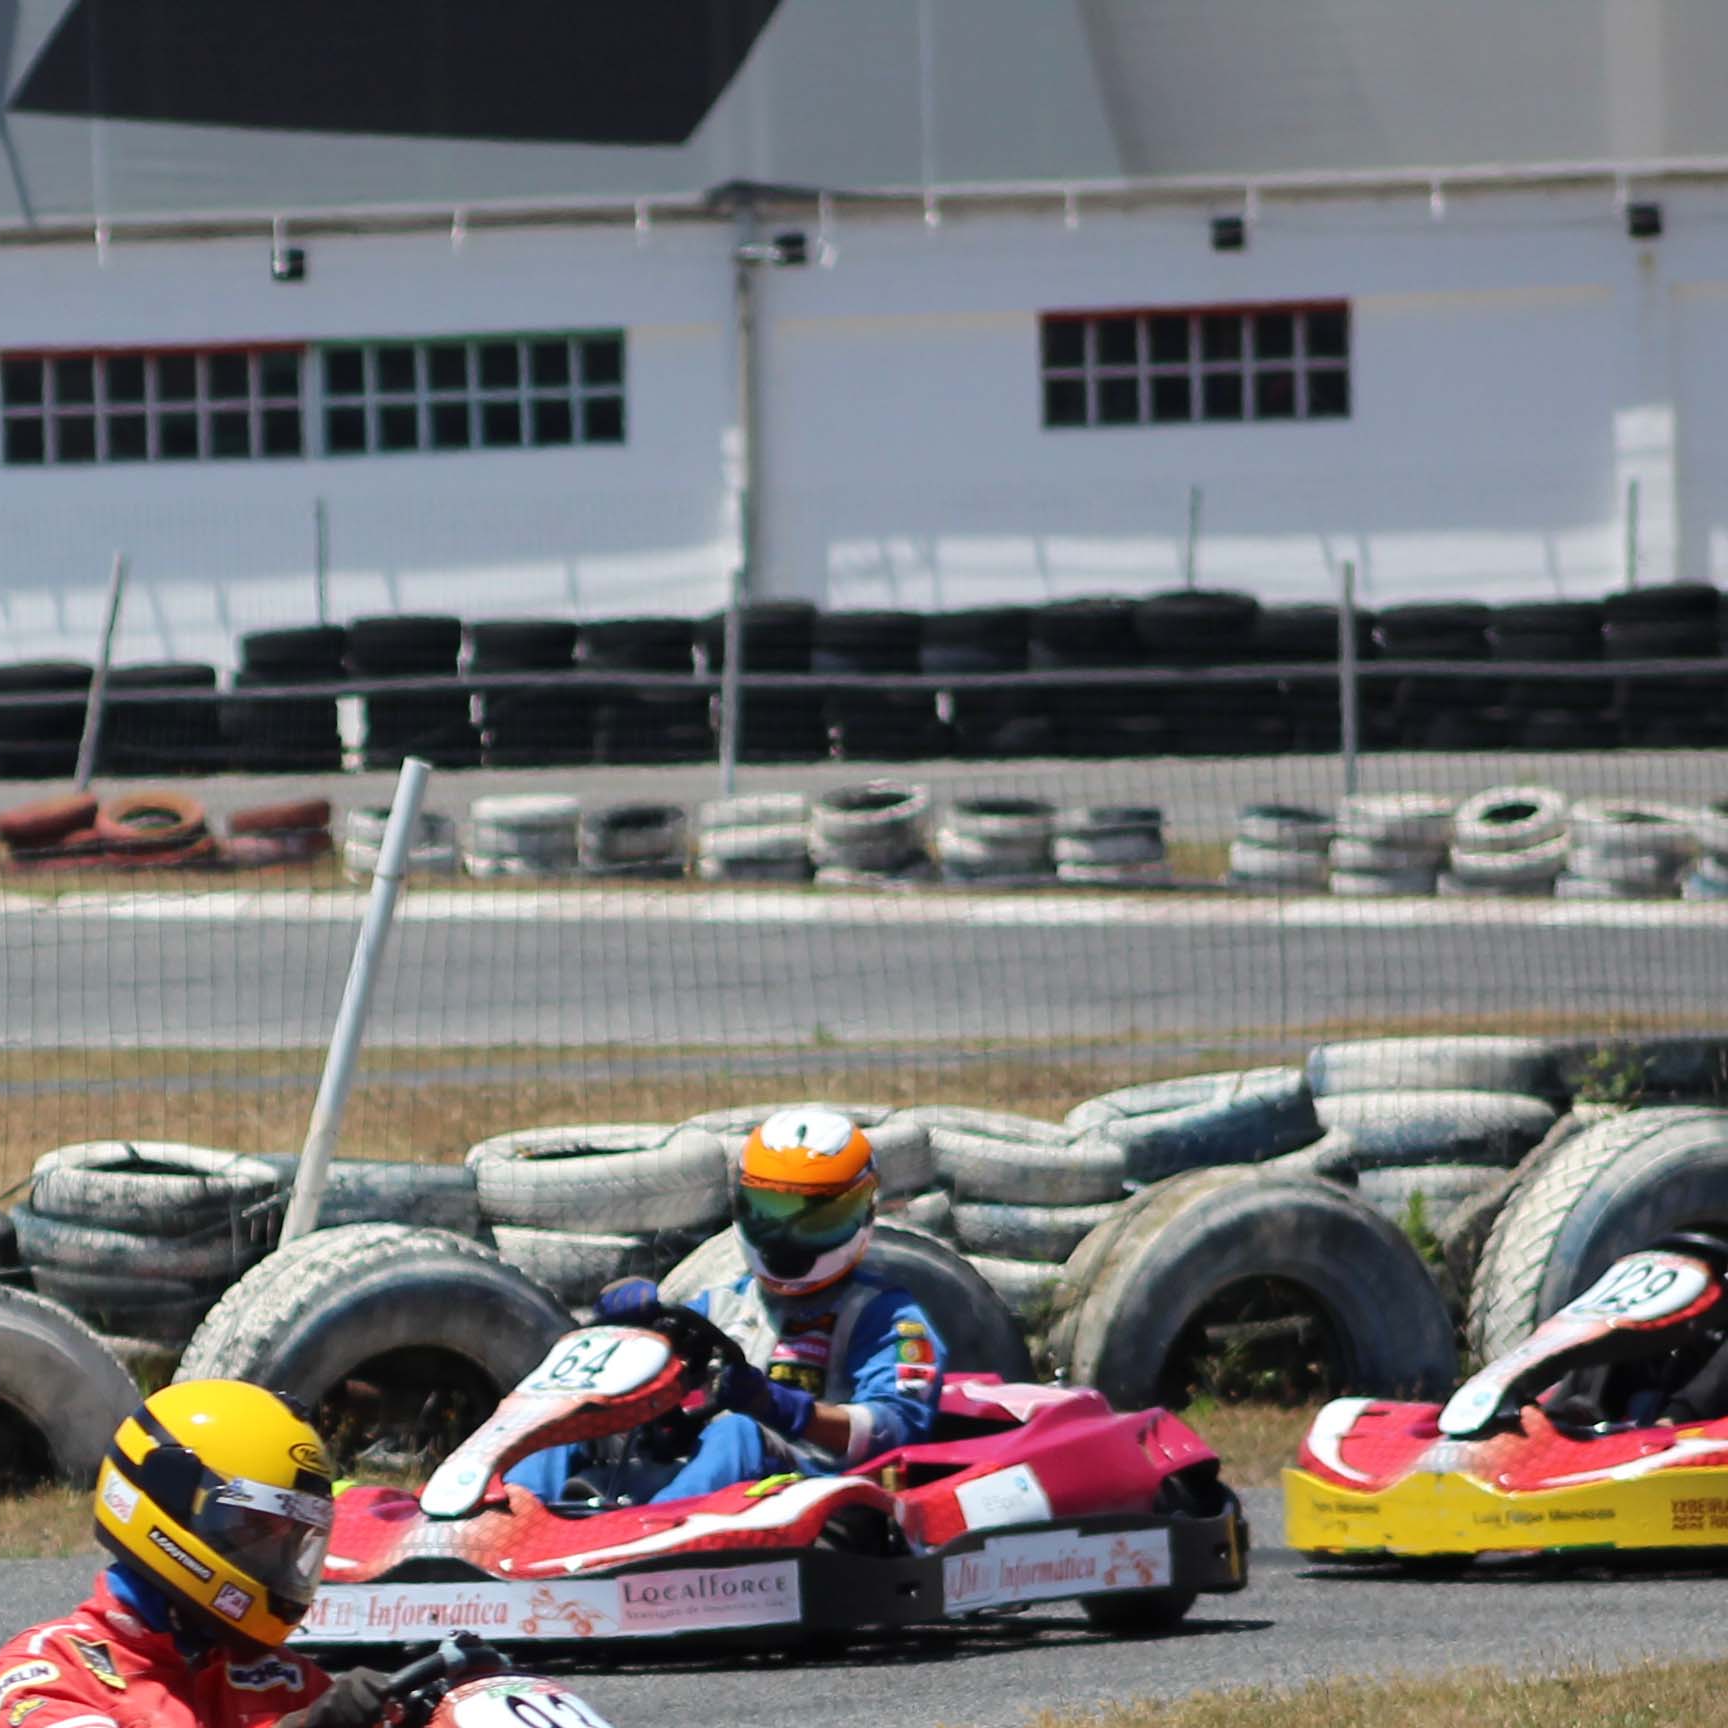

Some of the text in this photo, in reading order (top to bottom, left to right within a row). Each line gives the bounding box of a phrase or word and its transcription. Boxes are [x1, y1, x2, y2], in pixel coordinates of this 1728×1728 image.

[1591, 1262, 1679, 1305] 129
[550, 1339, 623, 1380] 64
[366, 1592, 508, 1634] Informática
